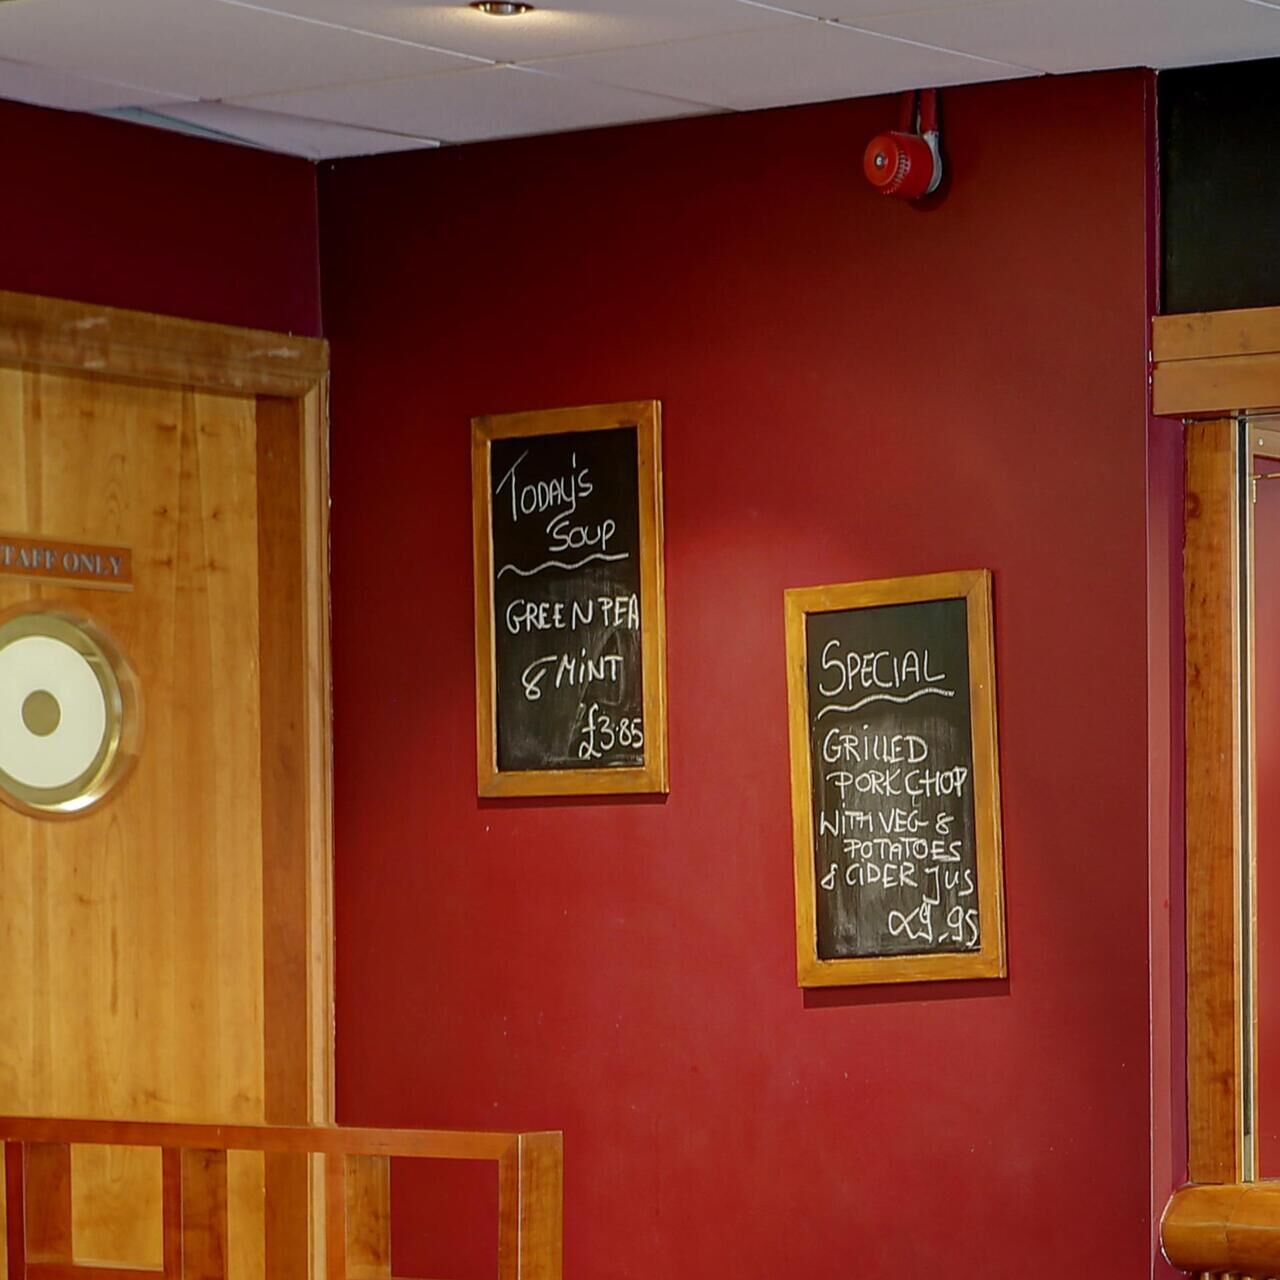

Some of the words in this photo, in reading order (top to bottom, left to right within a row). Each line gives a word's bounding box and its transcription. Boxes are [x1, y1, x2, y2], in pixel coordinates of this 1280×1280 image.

[496, 449, 593, 523] TODAY'S
[547, 517, 616, 553] SOUP
[62, 550, 121, 577] ONLY
[506, 599, 592, 635] GREEN
[593, 592, 640, 633] PEA
[555, 648, 623, 689] MINT
[819, 640, 945, 697] SPECIAL
[578, 702, 645, 760] £3.85
[823, 724, 929, 764] GRILLED
[826, 770, 902, 800] PORK
[904, 766, 968, 805] CHOP
[820, 803, 873, 838] WITH
[878, 810, 930, 834] VEG
[935, 812, 956, 836] &
[843, 838, 961, 863] POTATOES
[845, 858, 918, 888] CIDER
[923, 865, 975, 906] JUS
